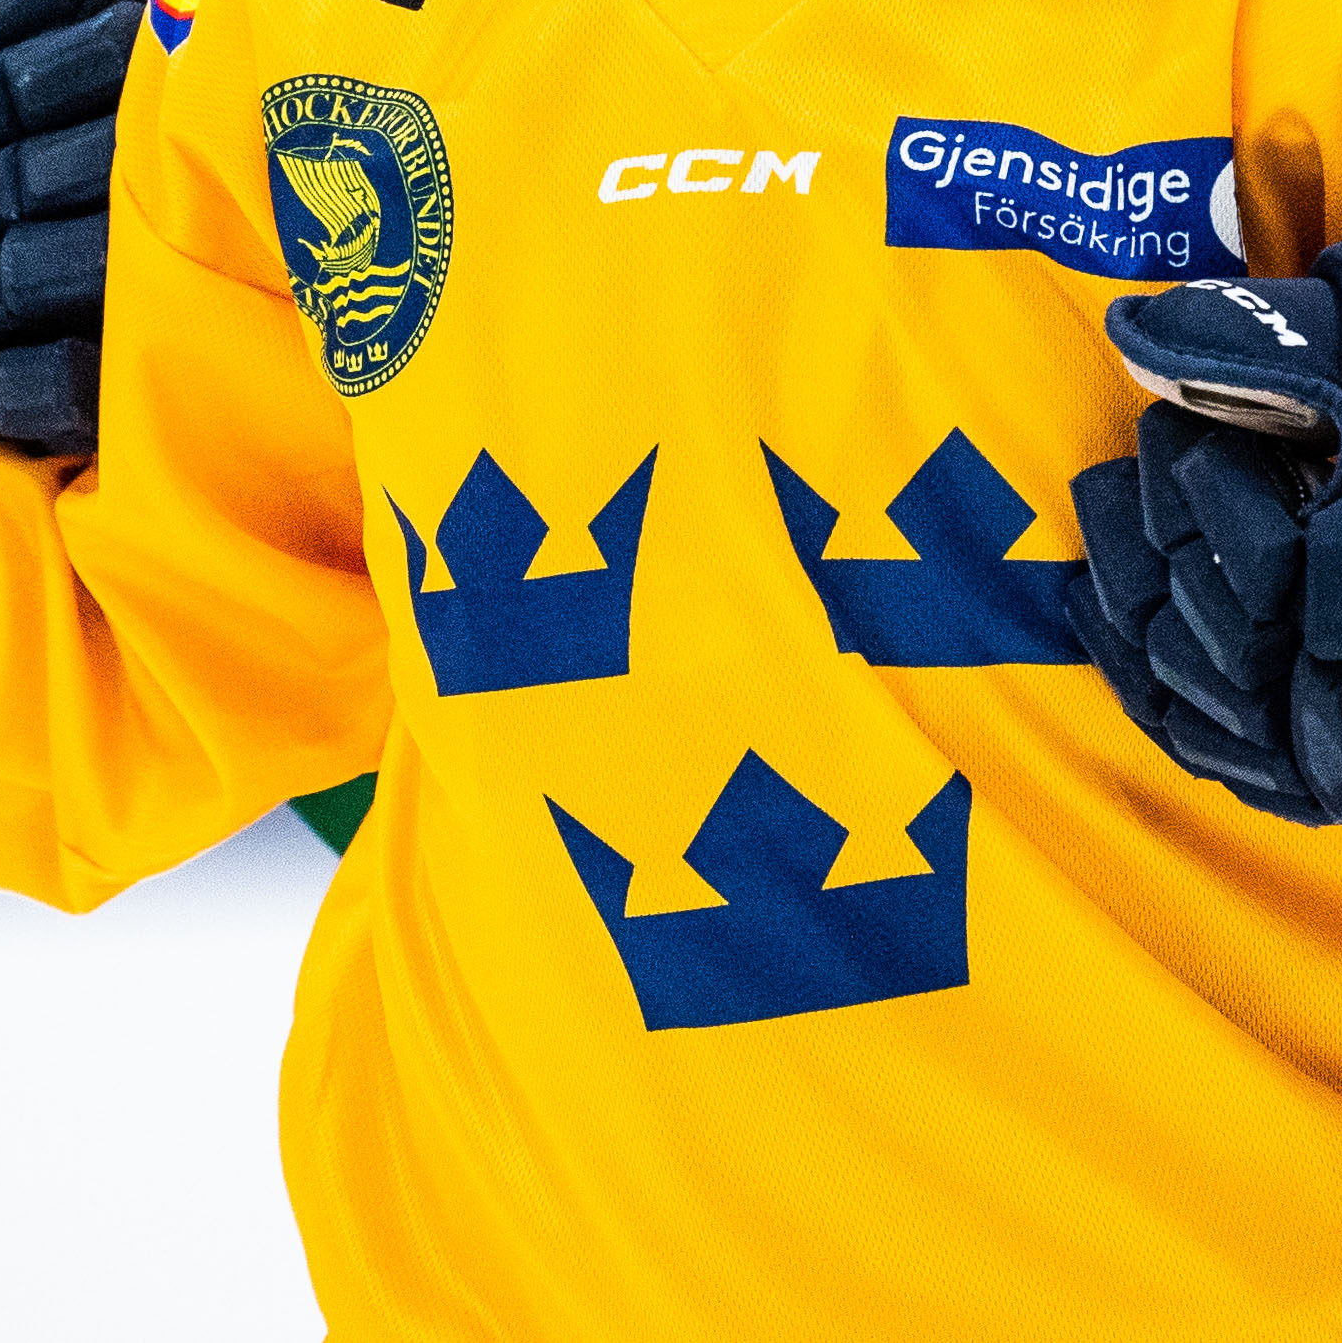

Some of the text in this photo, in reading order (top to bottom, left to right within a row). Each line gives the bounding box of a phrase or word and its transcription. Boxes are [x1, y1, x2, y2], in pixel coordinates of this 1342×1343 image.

[597, 148, 822, 204] CCM
[898, 128, 1192, 223] Gjensidige
[973, 191, 1191, 267] Försäkring
[1182, 277, 1309, 348] CCM
